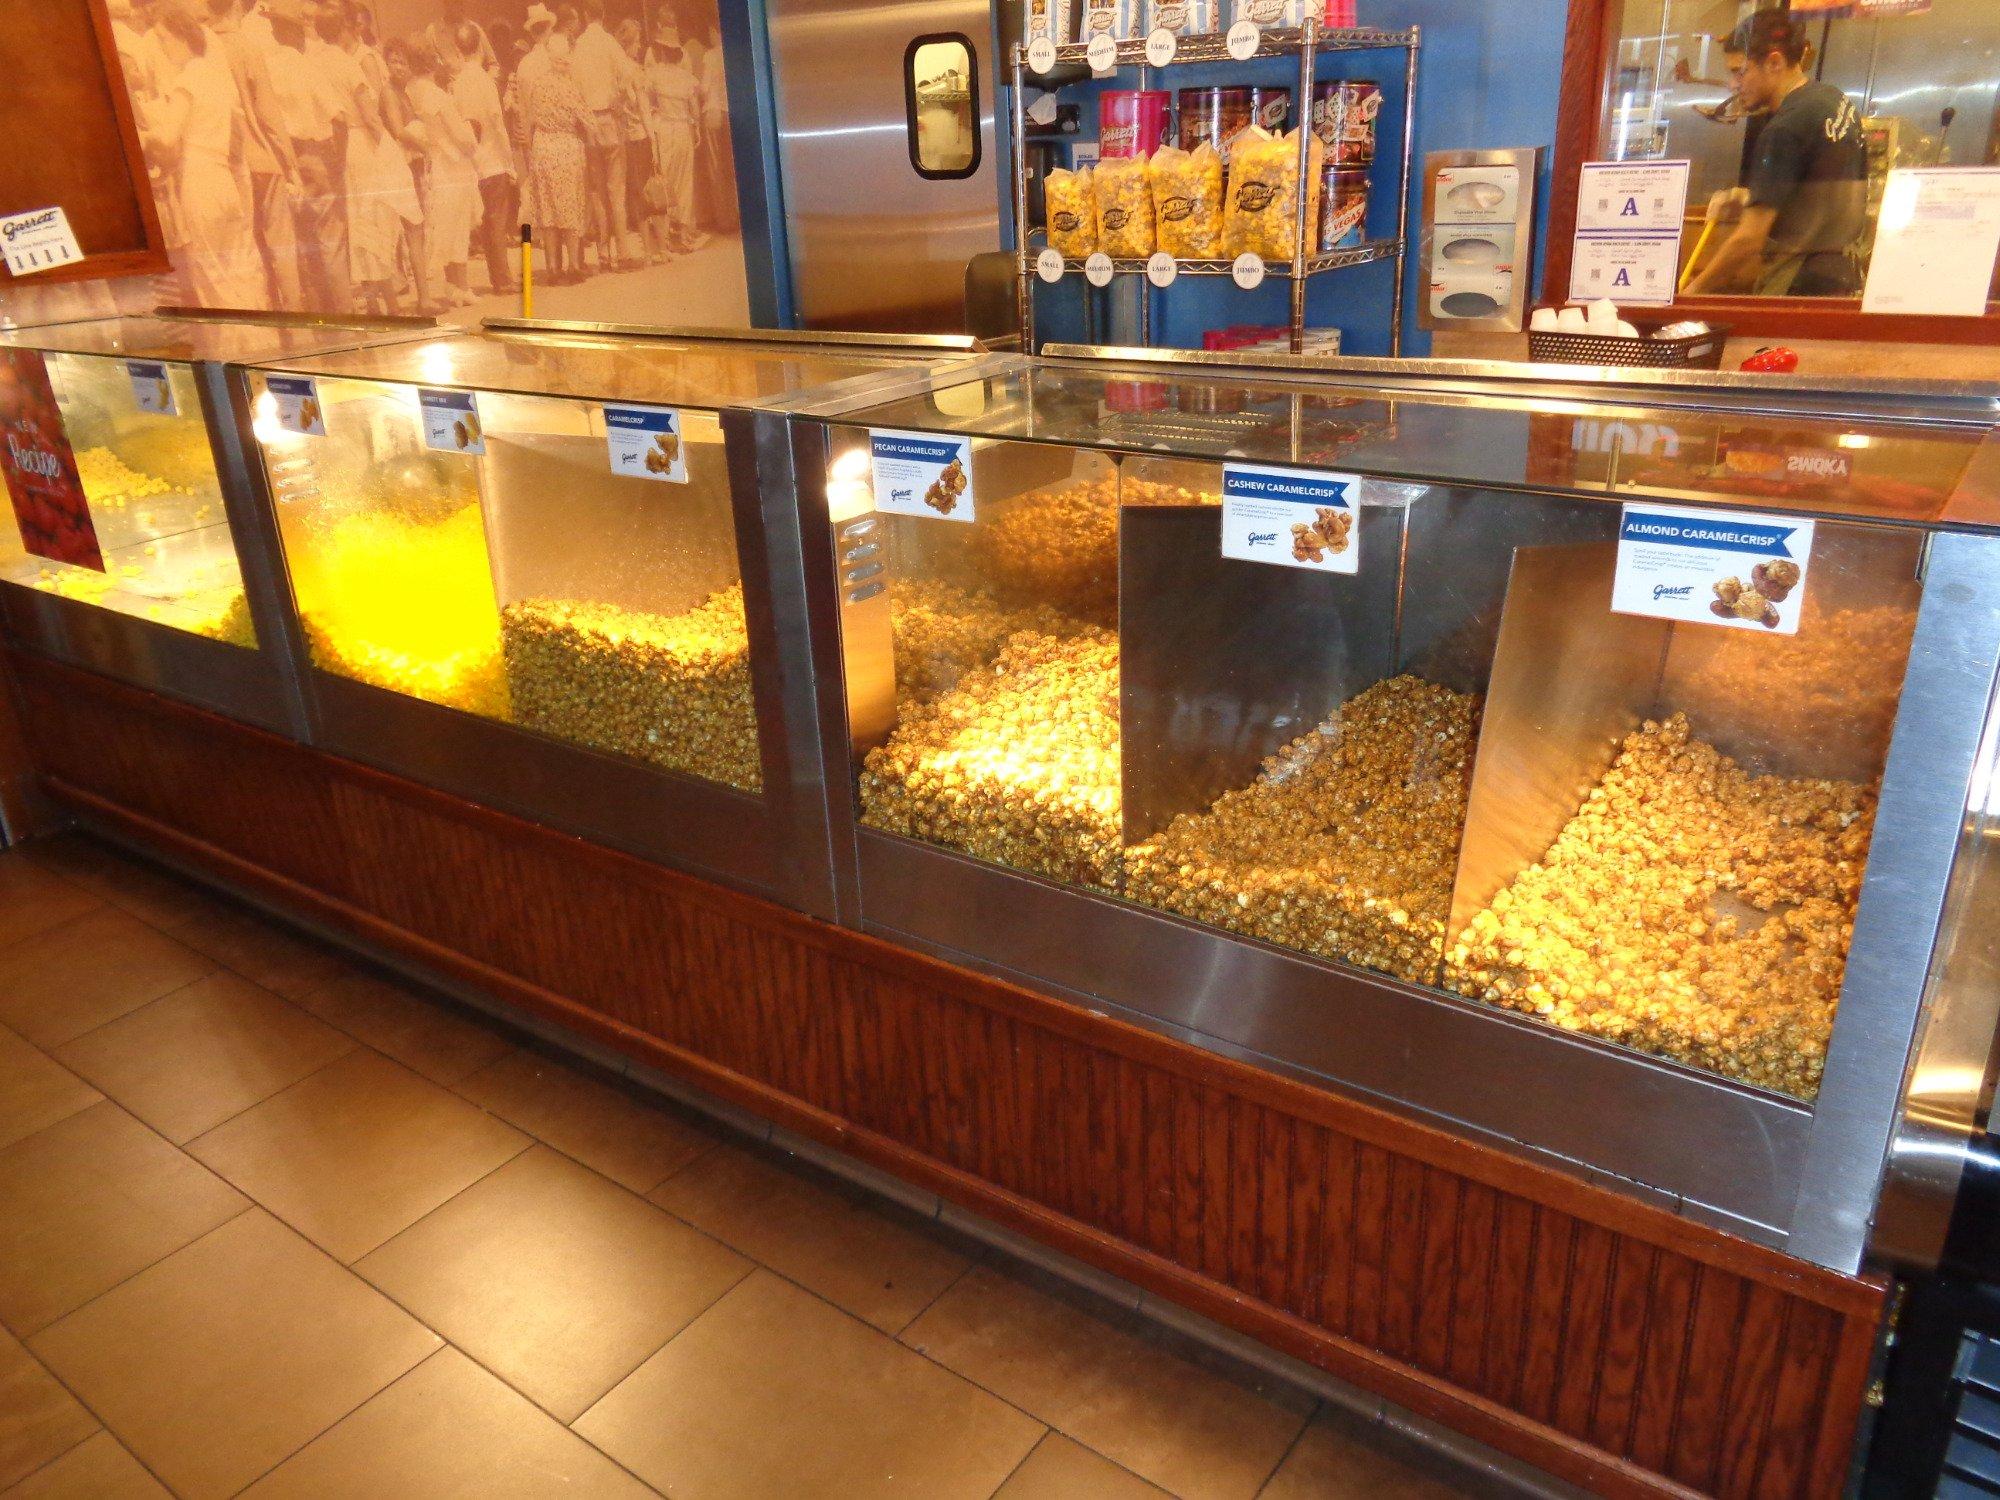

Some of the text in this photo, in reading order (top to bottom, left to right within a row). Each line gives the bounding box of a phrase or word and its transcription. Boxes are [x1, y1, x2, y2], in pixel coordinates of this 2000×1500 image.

[1150, 43, 1170, 51] LARGE
[1231, 35, 1255, 46] JUMBO
[1088, 46, 1114, 56] MEDIUM
[1619, 197, 1640, 216] A
[2, 210, 57, 241] Garrett
[1333, 208, 1362, 230] VEGAS
[1041, 261, 1059, 269] SMALL
[1237, 267, 1260, 275] JUMBO
[1611, 268, 1632, 287] A
[874, 443, 897, 452] PECAN
[7, 433, 60, 486] Recipe
[1227, 479, 1265, 491] CASHEW
[1626, 523, 1680, 538] ALMOND
[1248, 532, 1280, 546] Garrett
[1653, 584, 1696, 601] Garrett
